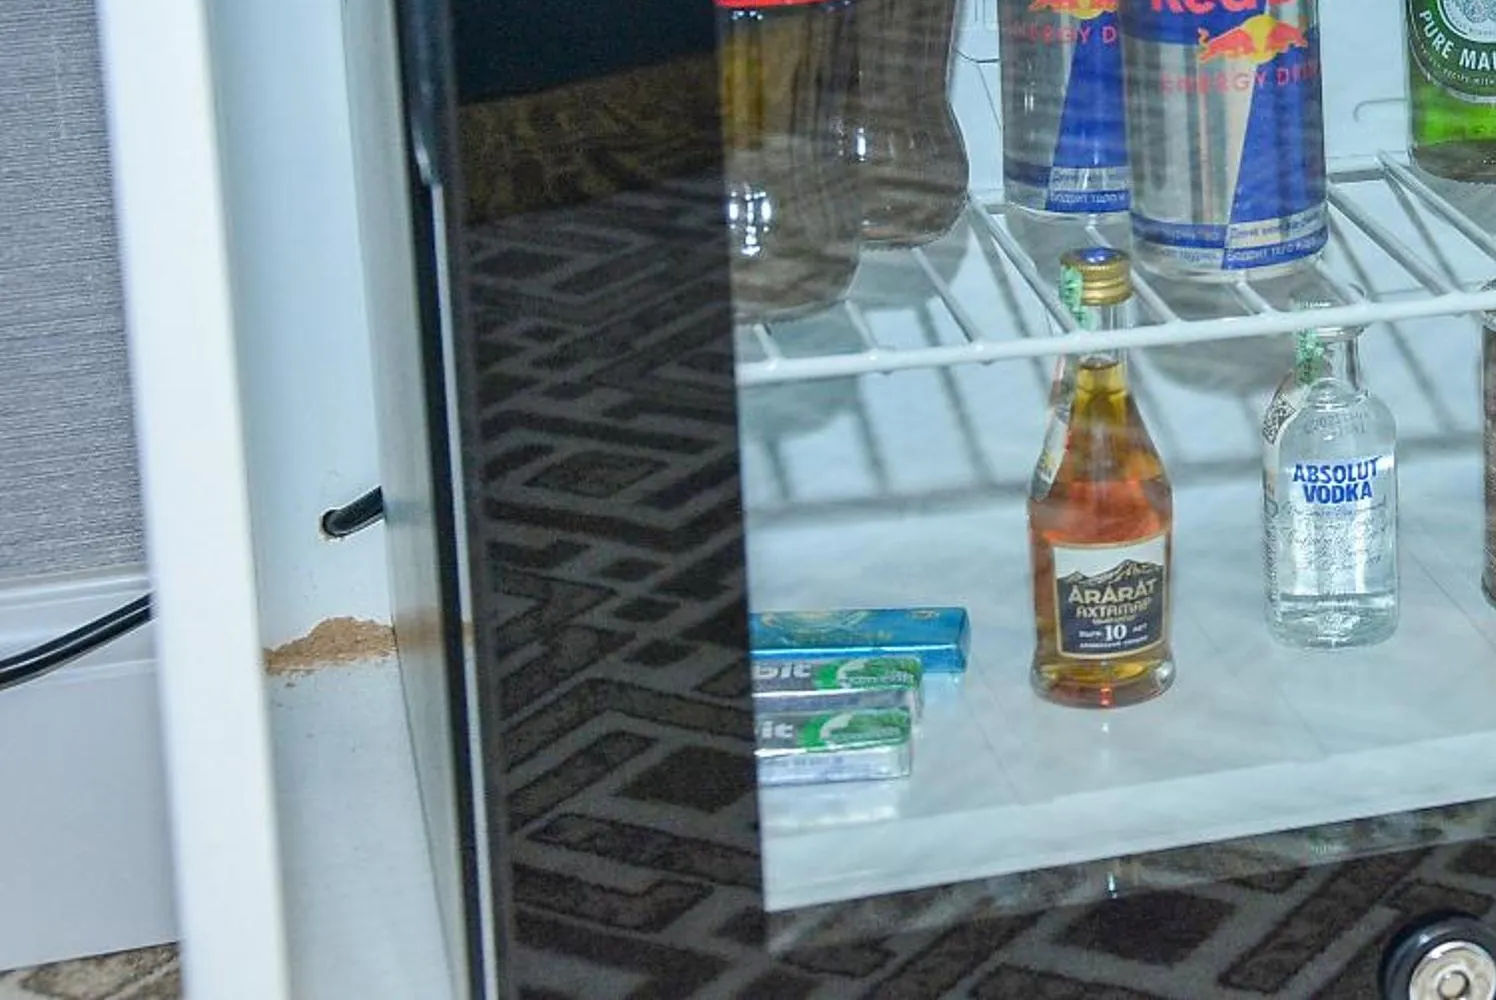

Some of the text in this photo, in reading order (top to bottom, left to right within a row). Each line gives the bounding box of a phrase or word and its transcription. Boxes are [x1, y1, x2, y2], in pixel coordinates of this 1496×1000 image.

[1419, 10, 1454, 60] PURE
[1292, 456, 1381, 484] ABSOLUT
[1302, 482, 1373, 504] VODKA
[1068, 577, 1158, 604] ARARAT
[1105, 624, 1128, 641] 10
[752, 662, 812, 679] bit
